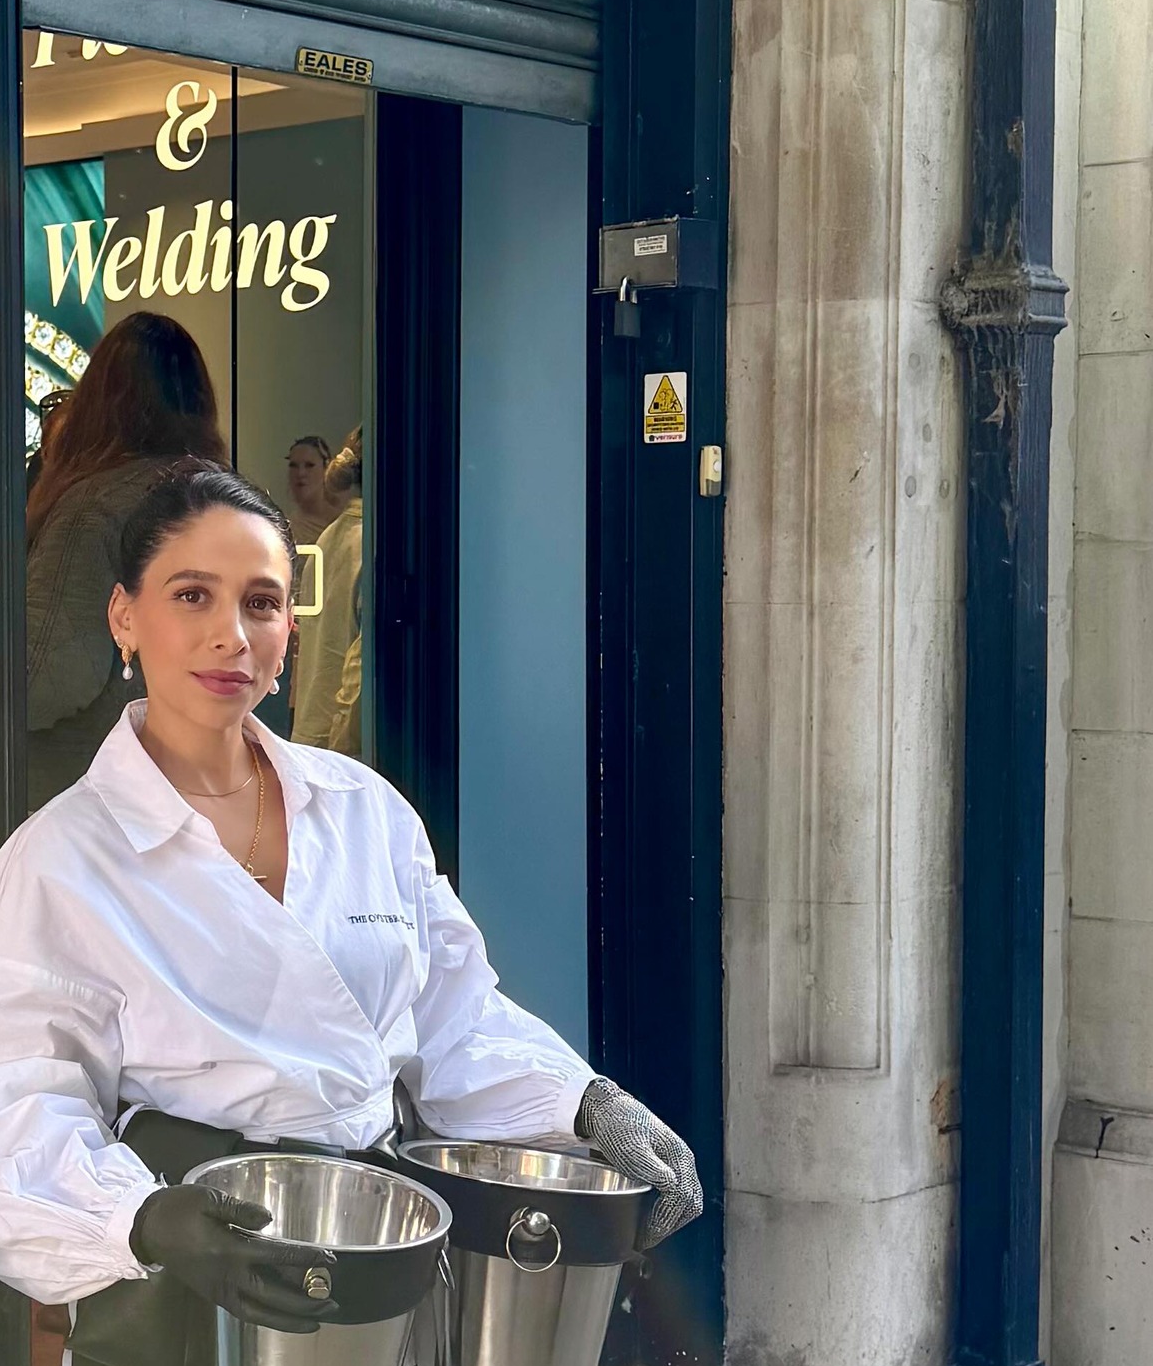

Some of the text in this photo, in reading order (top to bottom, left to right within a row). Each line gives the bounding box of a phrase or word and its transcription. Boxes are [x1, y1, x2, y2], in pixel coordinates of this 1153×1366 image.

[304, 51, 368, 76] EALES
[155, 81, 218, 172] &
[44, 200, 337, 312] Welding
[347, 915, 368, 924] THE
